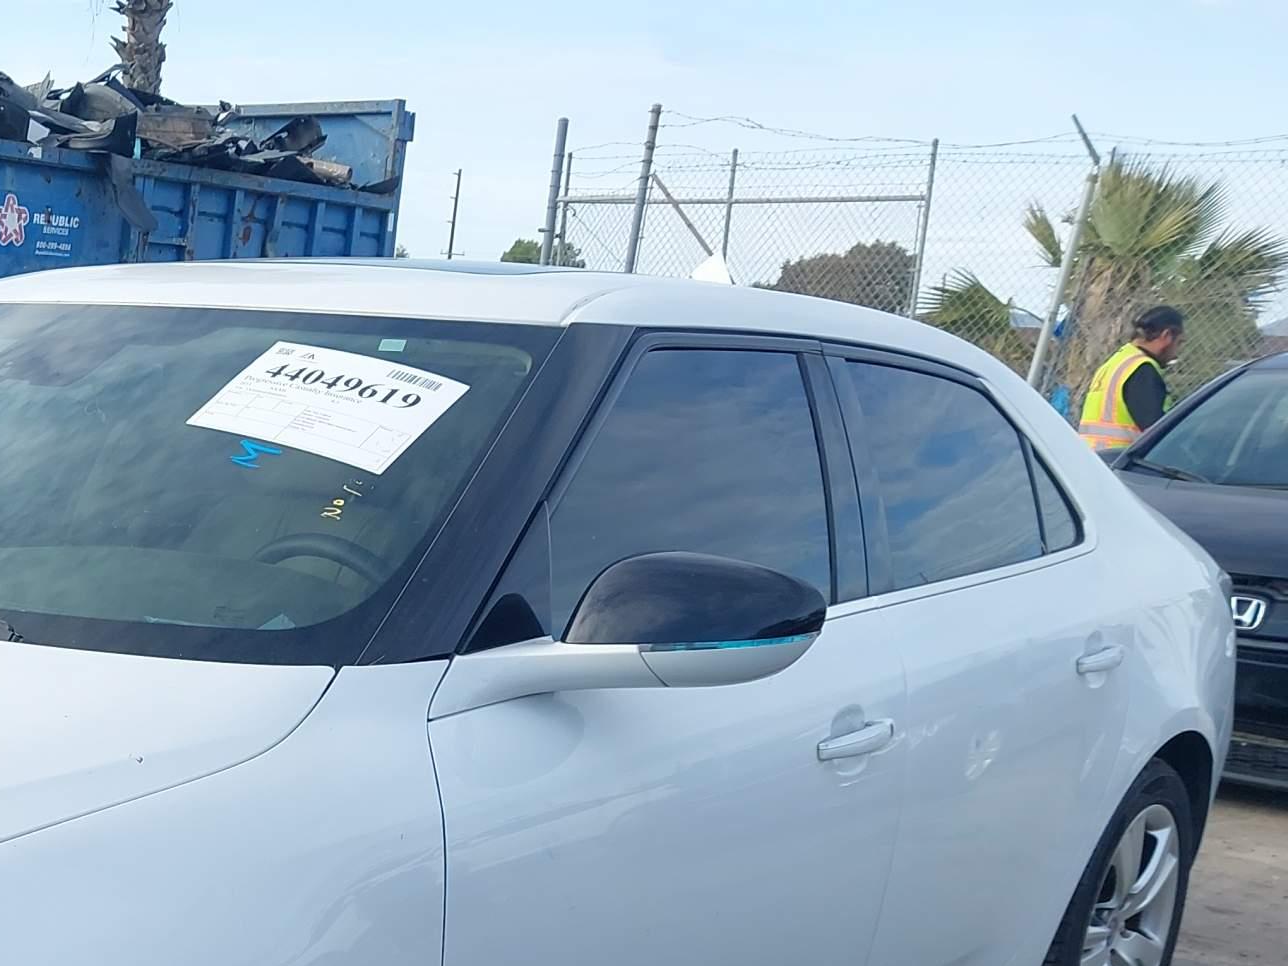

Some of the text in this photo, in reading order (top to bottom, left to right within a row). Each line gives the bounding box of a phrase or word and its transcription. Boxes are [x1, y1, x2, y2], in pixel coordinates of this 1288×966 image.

[33, 213, 80, 228] REUBLIC
[244, 375, 289, 388] Progressive
[289, 382, 322, 394] Casualty
[324, 391, 363, 403] Insurance
[264, 363, 422, 409] 44049619
